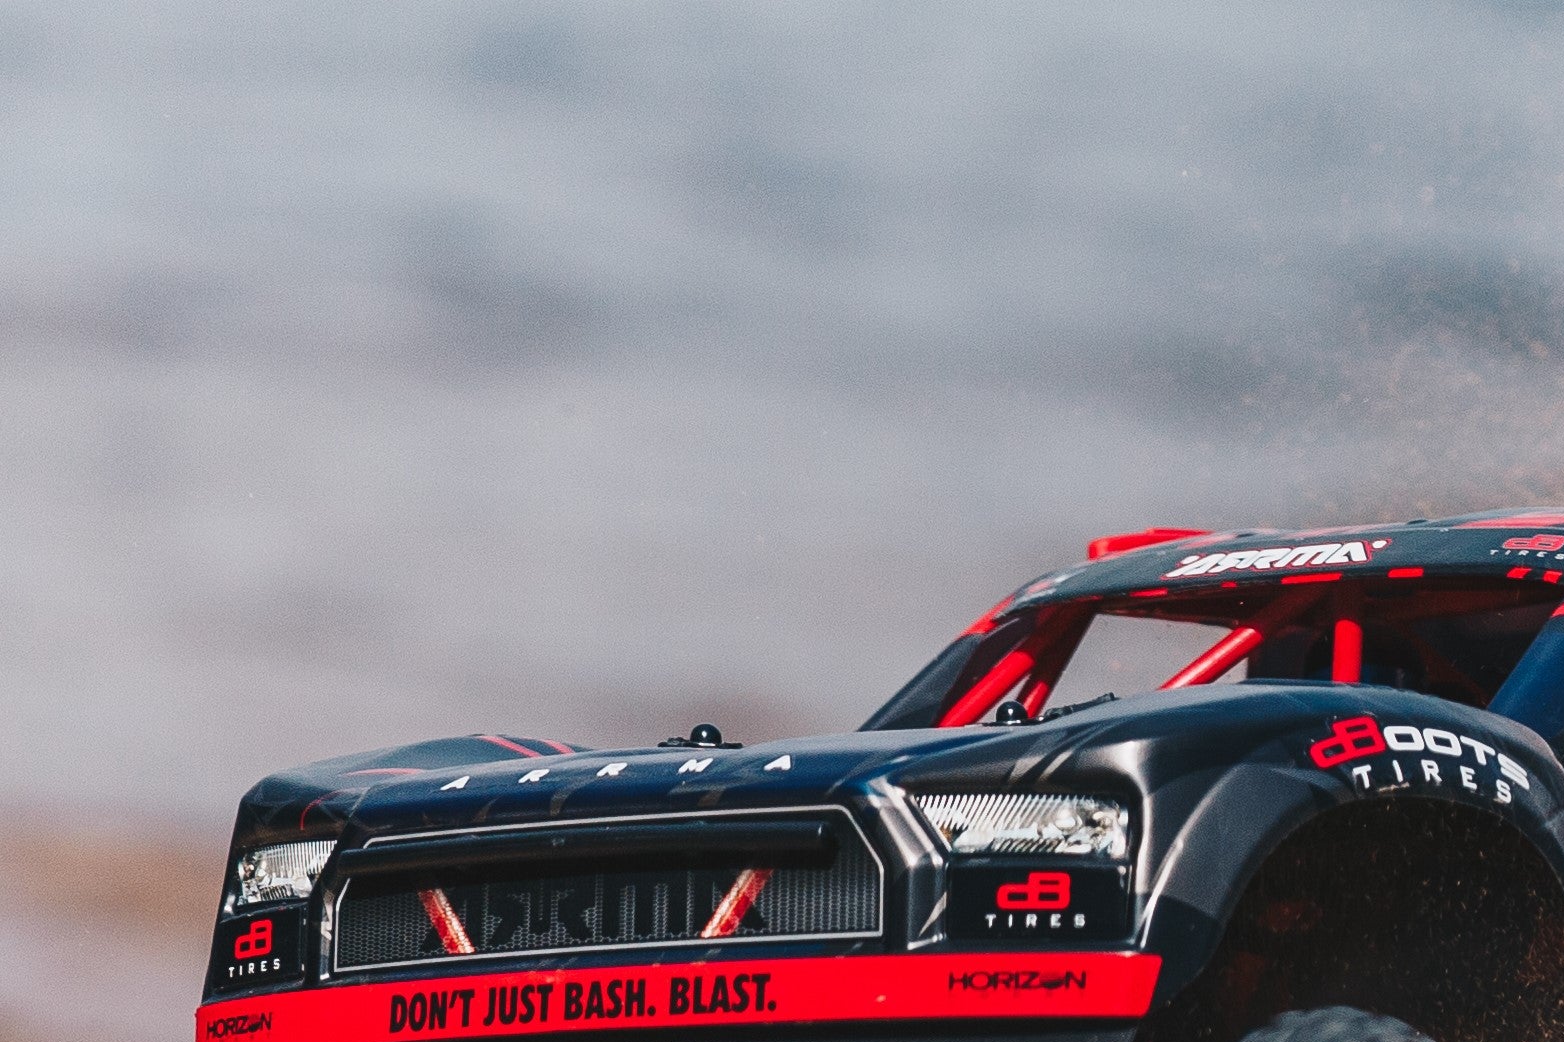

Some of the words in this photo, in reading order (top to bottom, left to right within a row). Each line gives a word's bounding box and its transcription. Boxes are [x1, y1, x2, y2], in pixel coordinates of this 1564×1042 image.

[440, 755, 792, 791] ARRMA
[1352, 759, 1512, 804] TIRES
[985, 913, 1086, 929] TIRES
[228, 958, 281, 978] TIRES
[949, 971, 1087, 991] HORIZON
[389, 988, 475, 1034] DON'T
[483, 983, 553, 1026] JUST
[564, 979, 656, 1020] BASH.
[669, 973, 777, 1015] BLAST.
[206, 1012, 273, 1040] HORIZON
